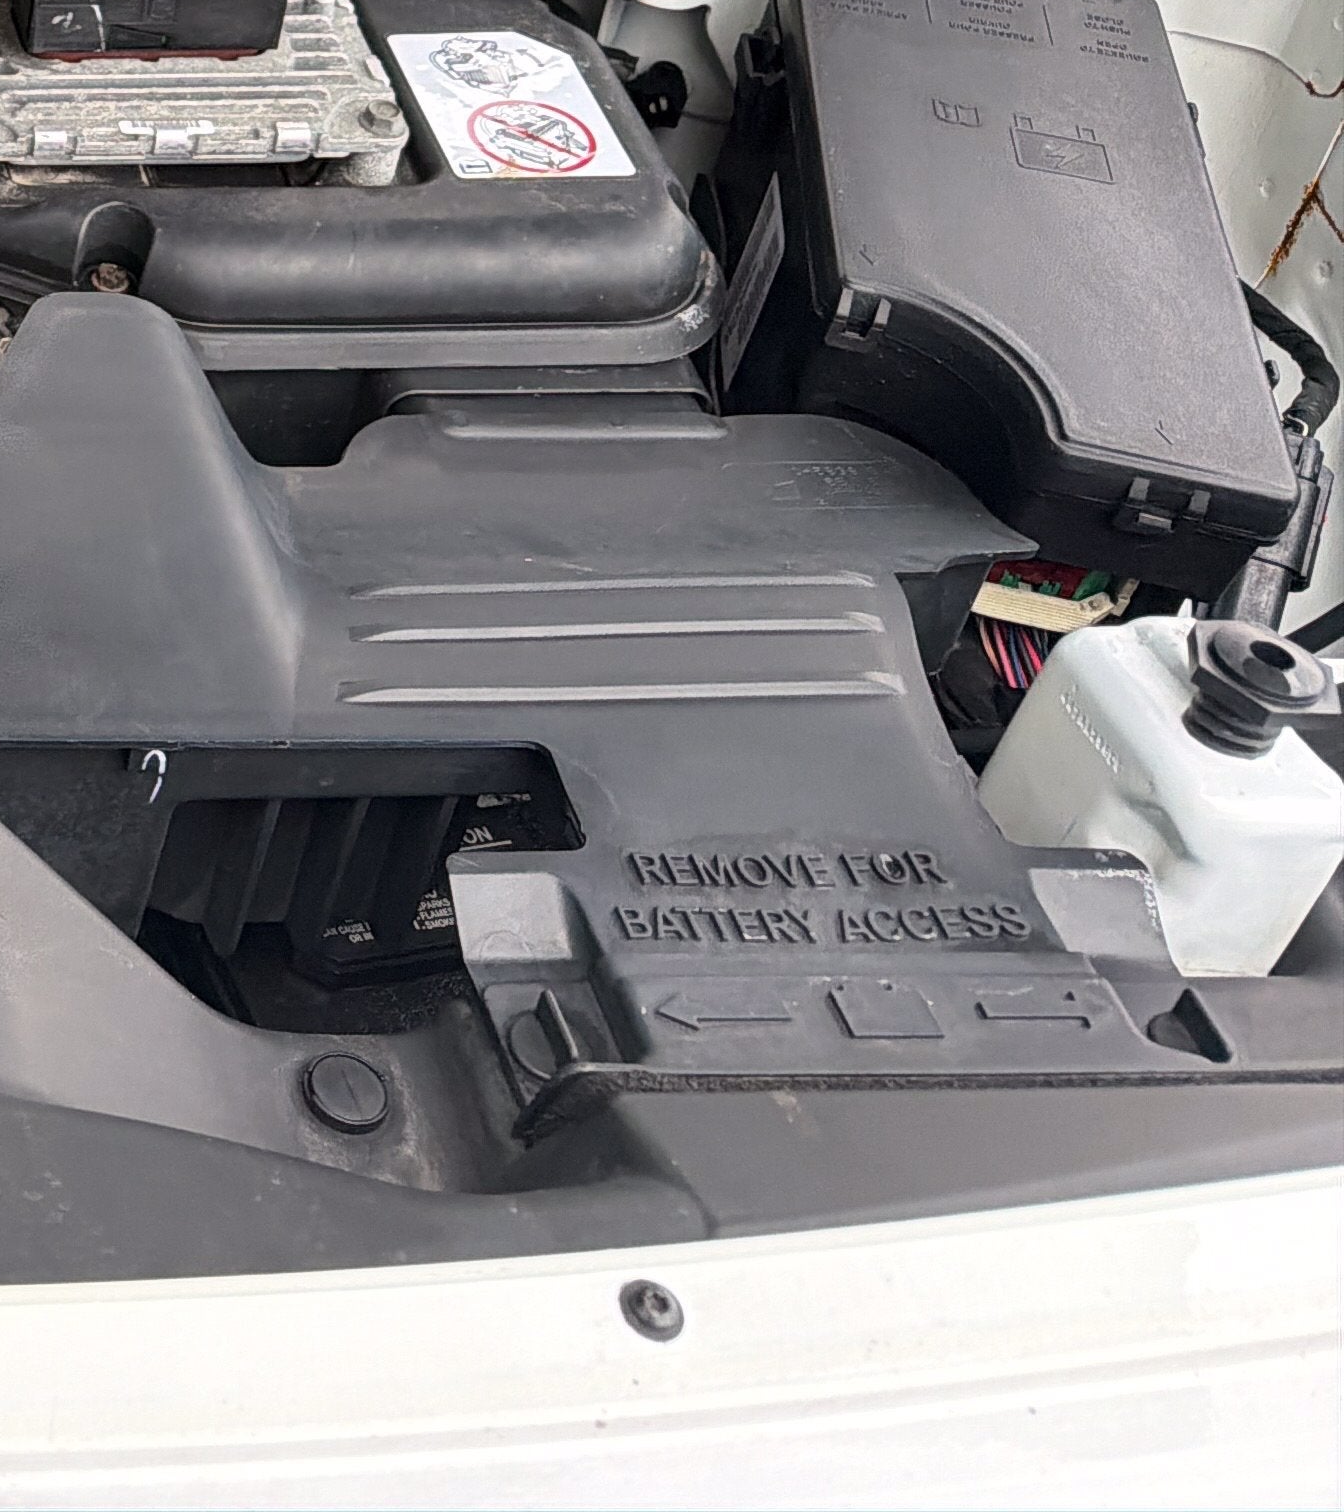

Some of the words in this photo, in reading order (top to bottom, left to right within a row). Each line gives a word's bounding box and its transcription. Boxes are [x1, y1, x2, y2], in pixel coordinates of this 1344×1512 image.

[626, 851, 836, 889] REMOVE
[839, 850, 950, 889] FOR
[612, 905, 816, 943] BATTERY
[837, 903, 1031, 943] ACCESS
